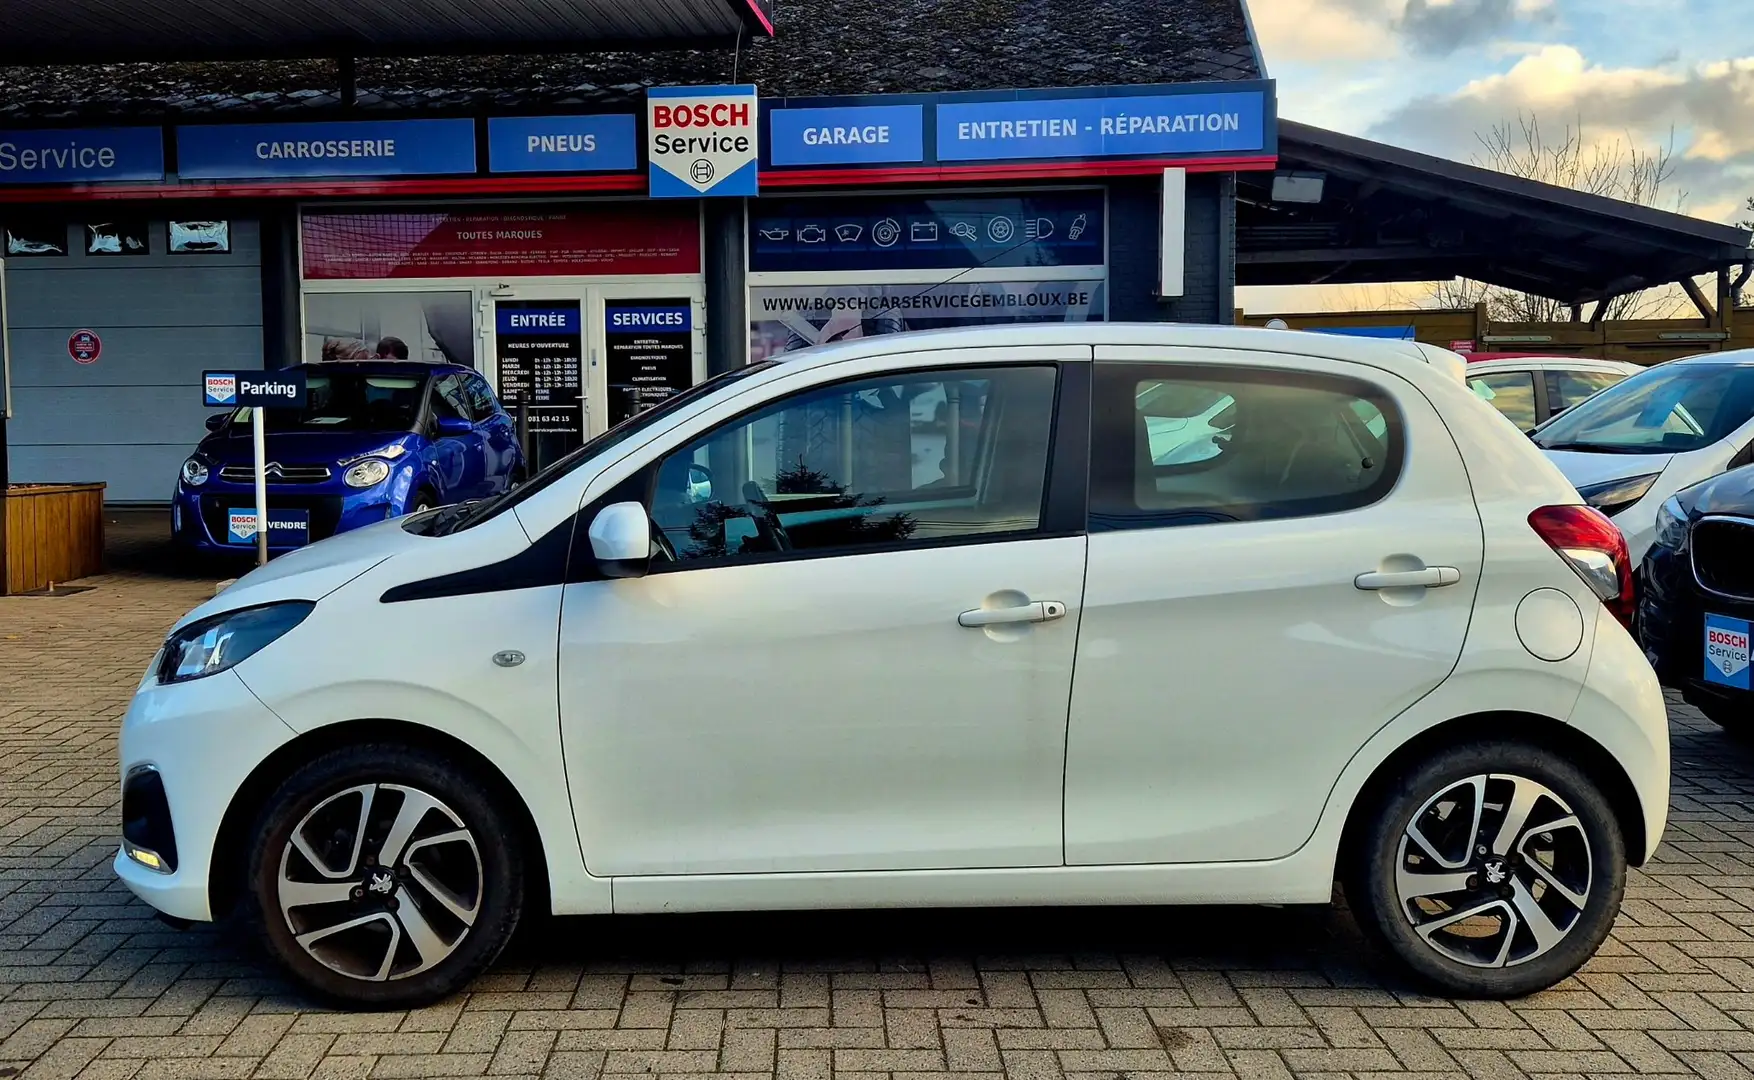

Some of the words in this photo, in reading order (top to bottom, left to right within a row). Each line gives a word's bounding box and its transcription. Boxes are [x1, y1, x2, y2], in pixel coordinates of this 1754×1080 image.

[653, 104, 749, 129] BOSCH
[958, 119, 1077, 140] ENTRETIEN
[1100, 112, 1239, 135] RÉPARATION
[527, 134, 596, 153] PNEUS
[654, 131, 749, 154] Service
[803, 126, 890, 145] GARAGE
[0, 141, 115, 170] Service
[256, 139, 396, 160] CARROSSERIE
[457, 231, 493, 240] TOUTES
[496, 230, 543, 240] MARQUES
[763, 291, 1088, 311] WWW.BOSCHCARSERVICEGEMBLOUX.BE
[510, 311, 566, 327] ENTRÉE
[613, 312, 683, 326] SERVICES
[207, 378, 233, 386] BOSCH
[240, 381, 297, 398] Parking
[267, 521, 306, 529] VENDRE
[1709, 630, 1747, 648] BOSCH
[1708, 645, 1747, 661] Service
